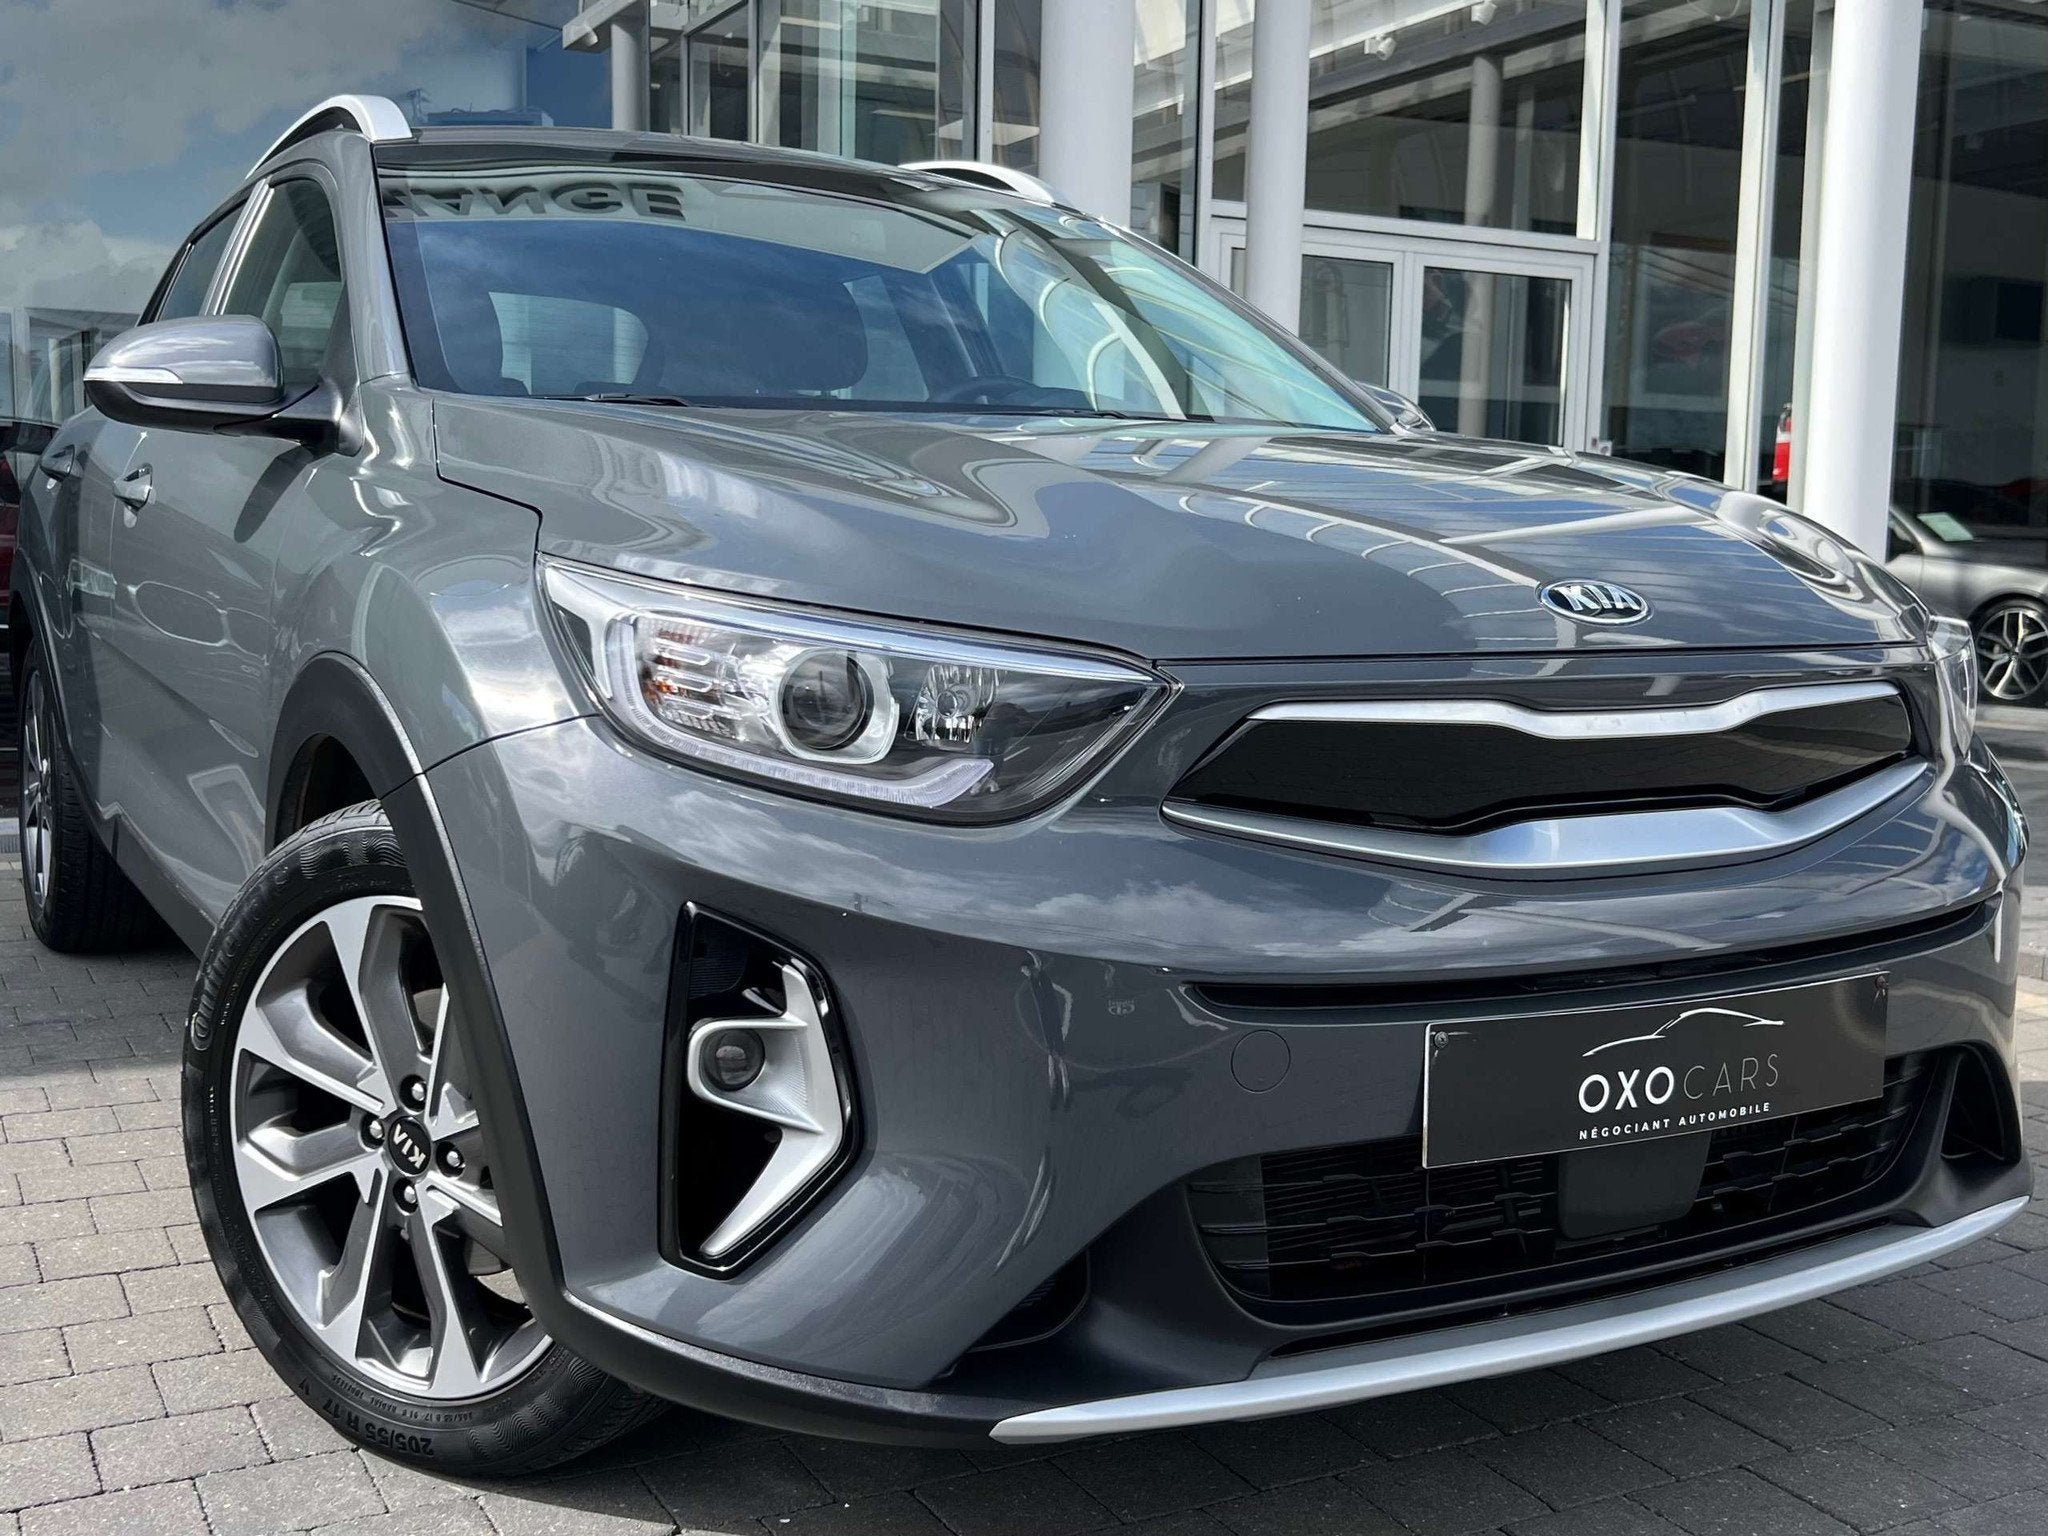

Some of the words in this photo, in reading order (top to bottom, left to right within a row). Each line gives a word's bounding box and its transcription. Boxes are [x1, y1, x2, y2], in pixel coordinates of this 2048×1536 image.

[1554, 585, 1641, 611] KIA
[1579, 1118, 1671, 1141] NÉGOCIANT
[1679, 1102, 1771, 1128] AUTOMOBILE
[393, 1123, 426, 1169] KIA
[322, 1399, 341, 1419] 17
[347, 1413, 360, 1433] R
[365, 1421, 435, 1456] 205/55
